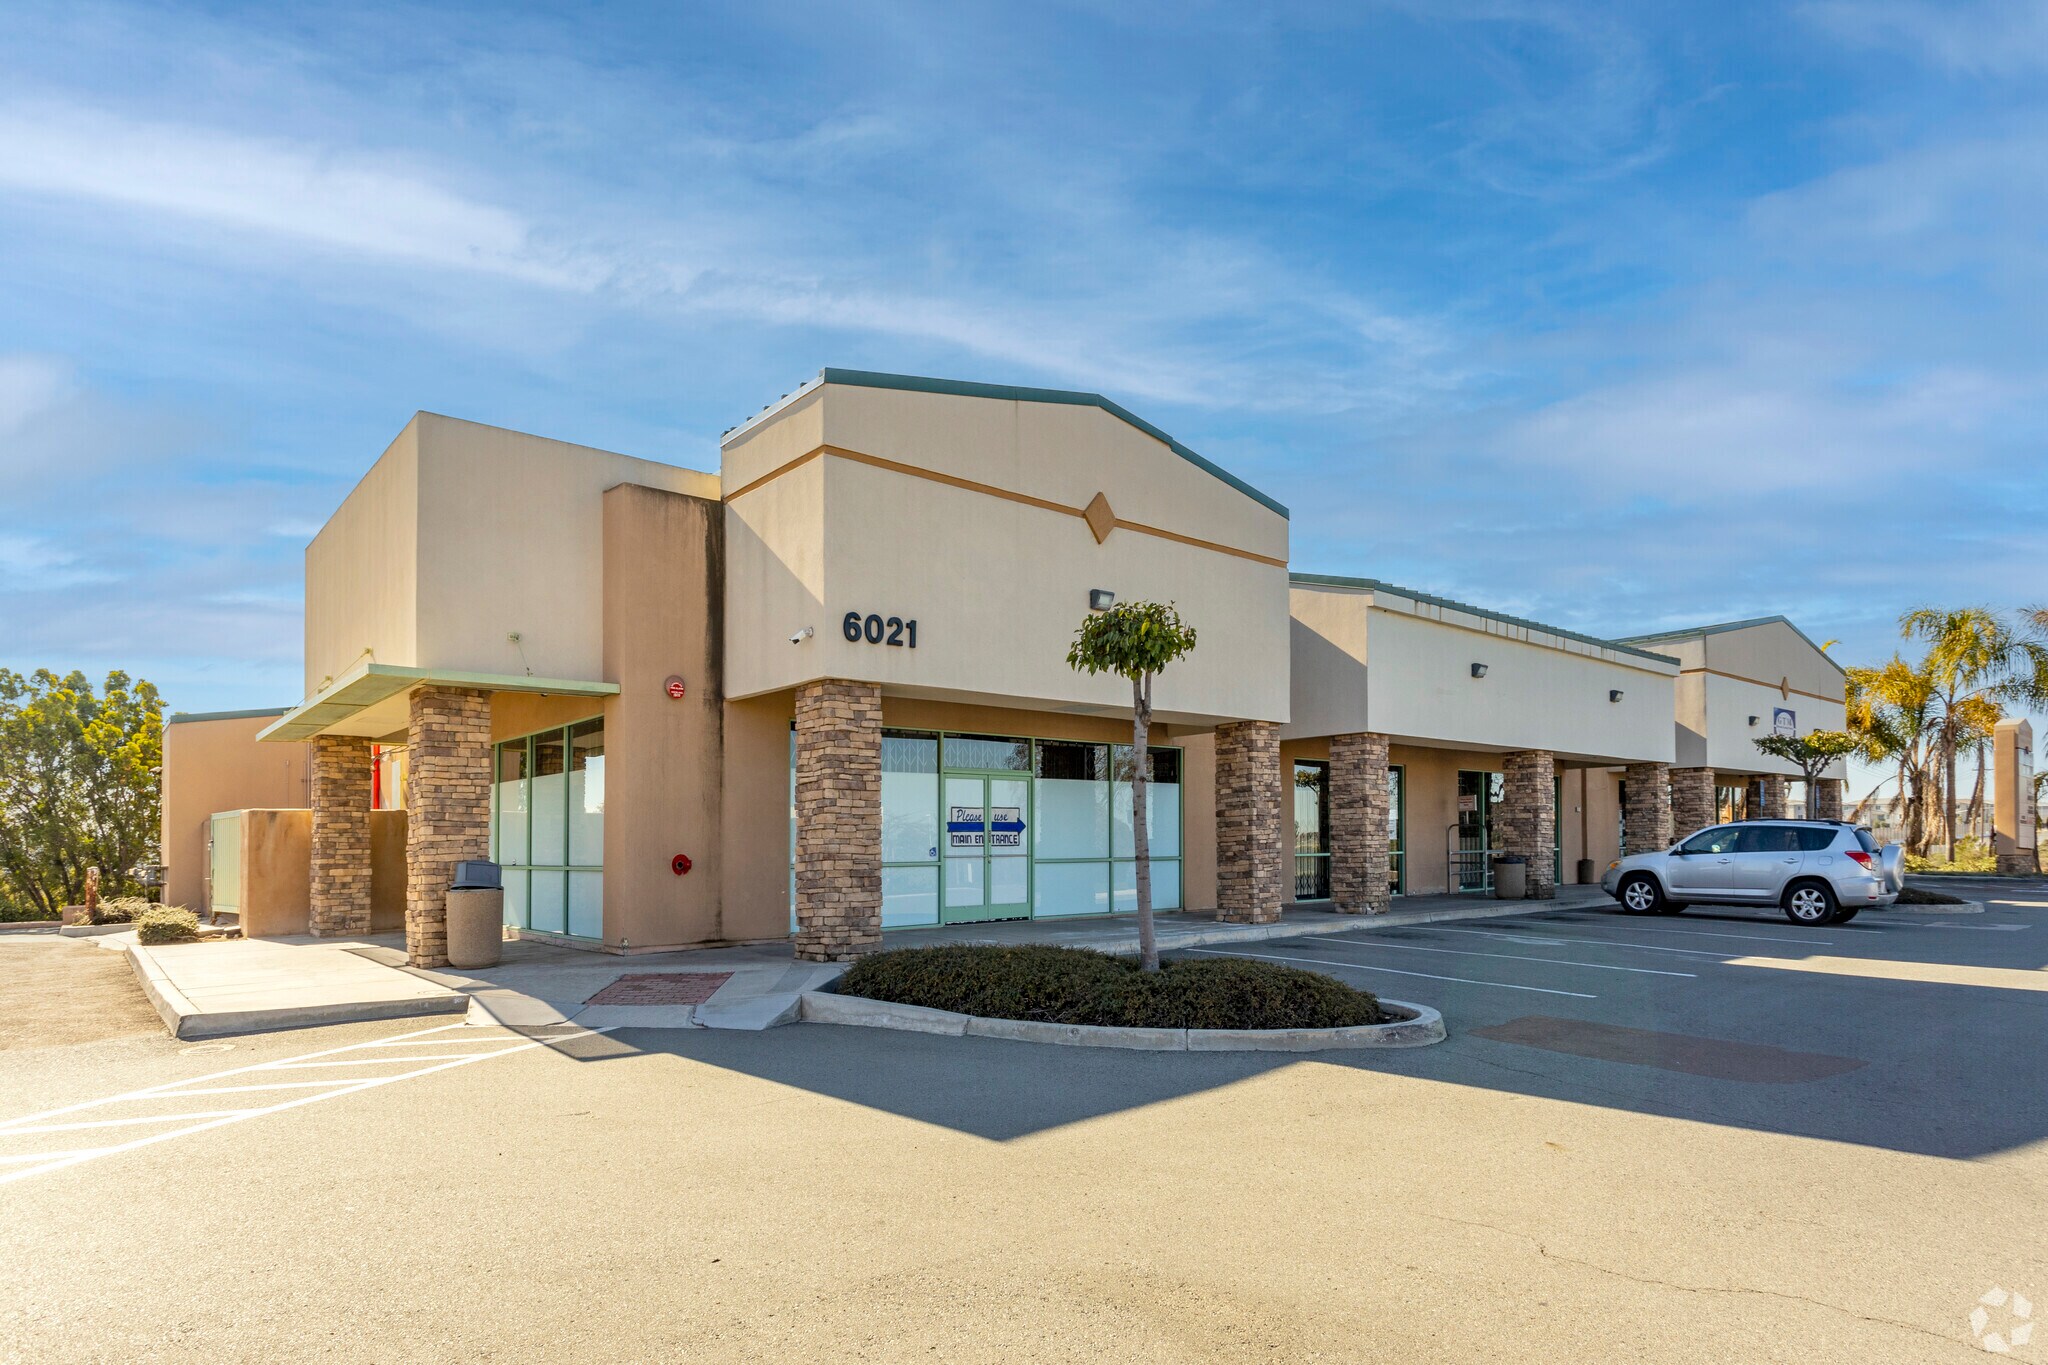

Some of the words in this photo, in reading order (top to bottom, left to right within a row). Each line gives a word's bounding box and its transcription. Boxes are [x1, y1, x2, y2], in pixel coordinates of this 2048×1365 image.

[843, 611, 917, 648] 6021
[956, 809, 982, 822] Please
[993, 813, 1008, 822] use
[952, 834, 972, 844] MAIN
